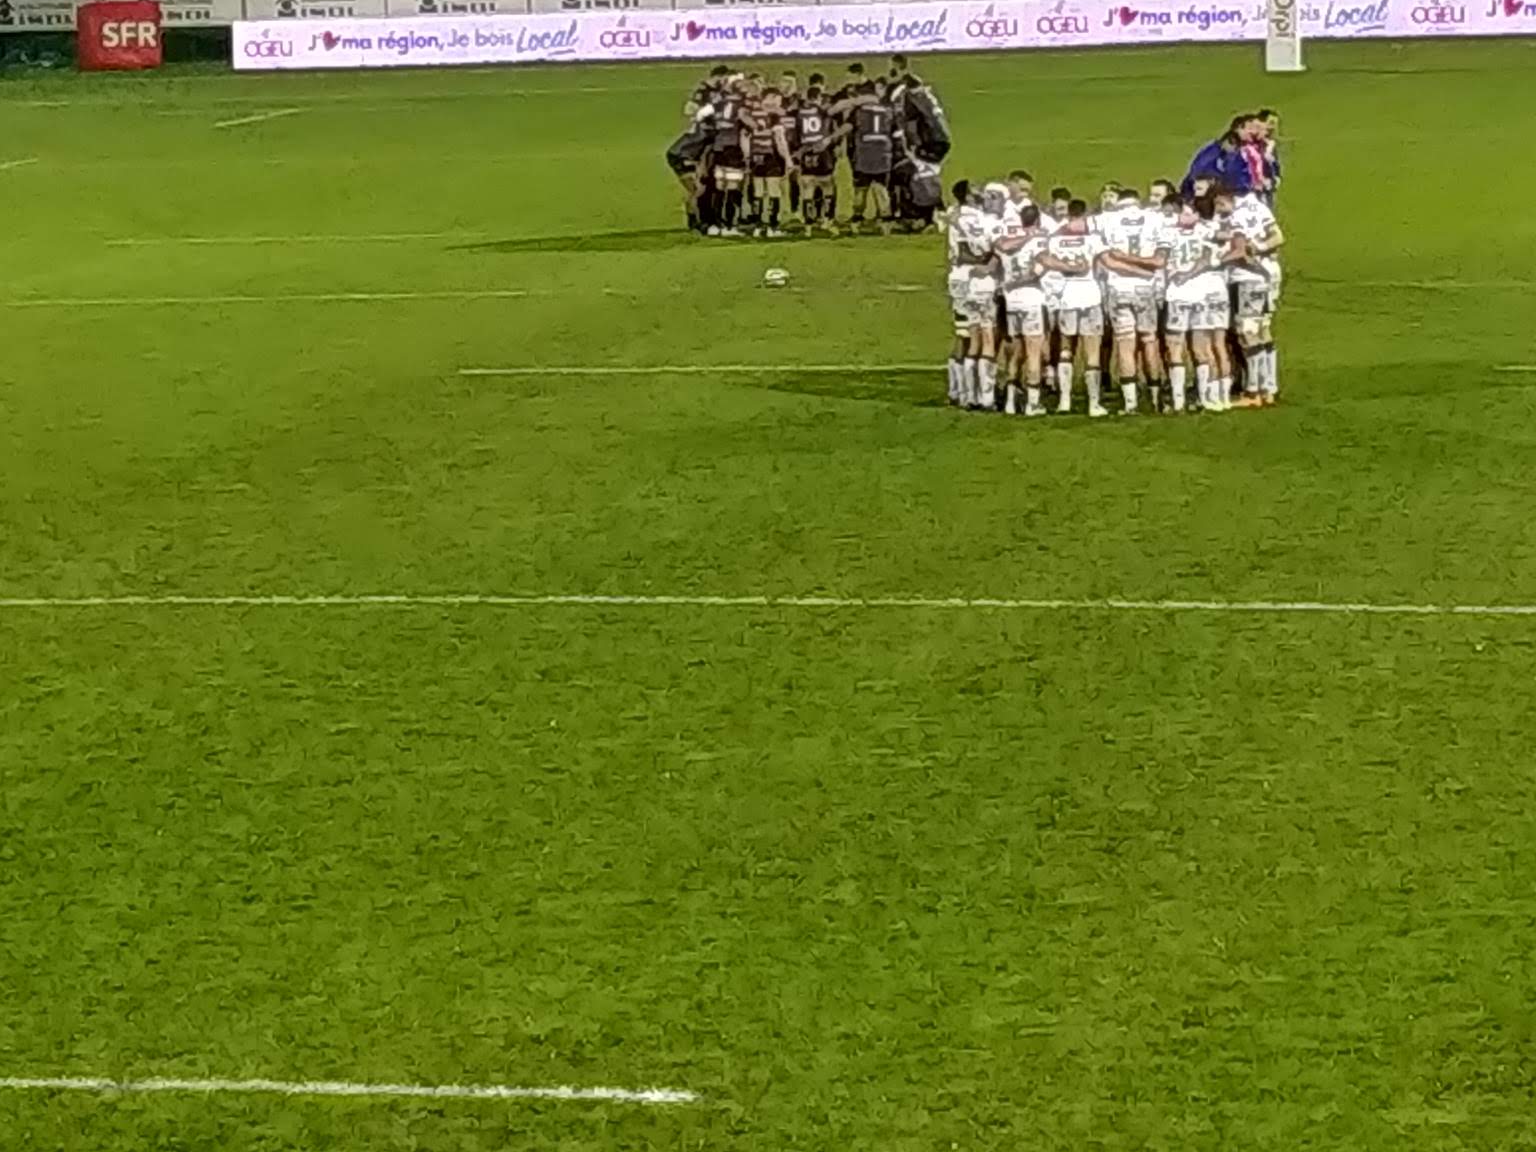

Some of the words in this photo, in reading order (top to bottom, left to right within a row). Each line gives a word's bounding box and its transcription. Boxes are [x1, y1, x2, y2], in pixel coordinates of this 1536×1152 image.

[706, 26, 737, 39] ma
[885, 9, 948, 42] Local
[1140, 11, 1172, 25] ma
[102, 22, 157, 48] SFR
[342, 36, 373, 48] ma
[516, 19, 578, 54] Local
[802, 116, 821, 134] 10
[873, 115, 880, 133] 1
